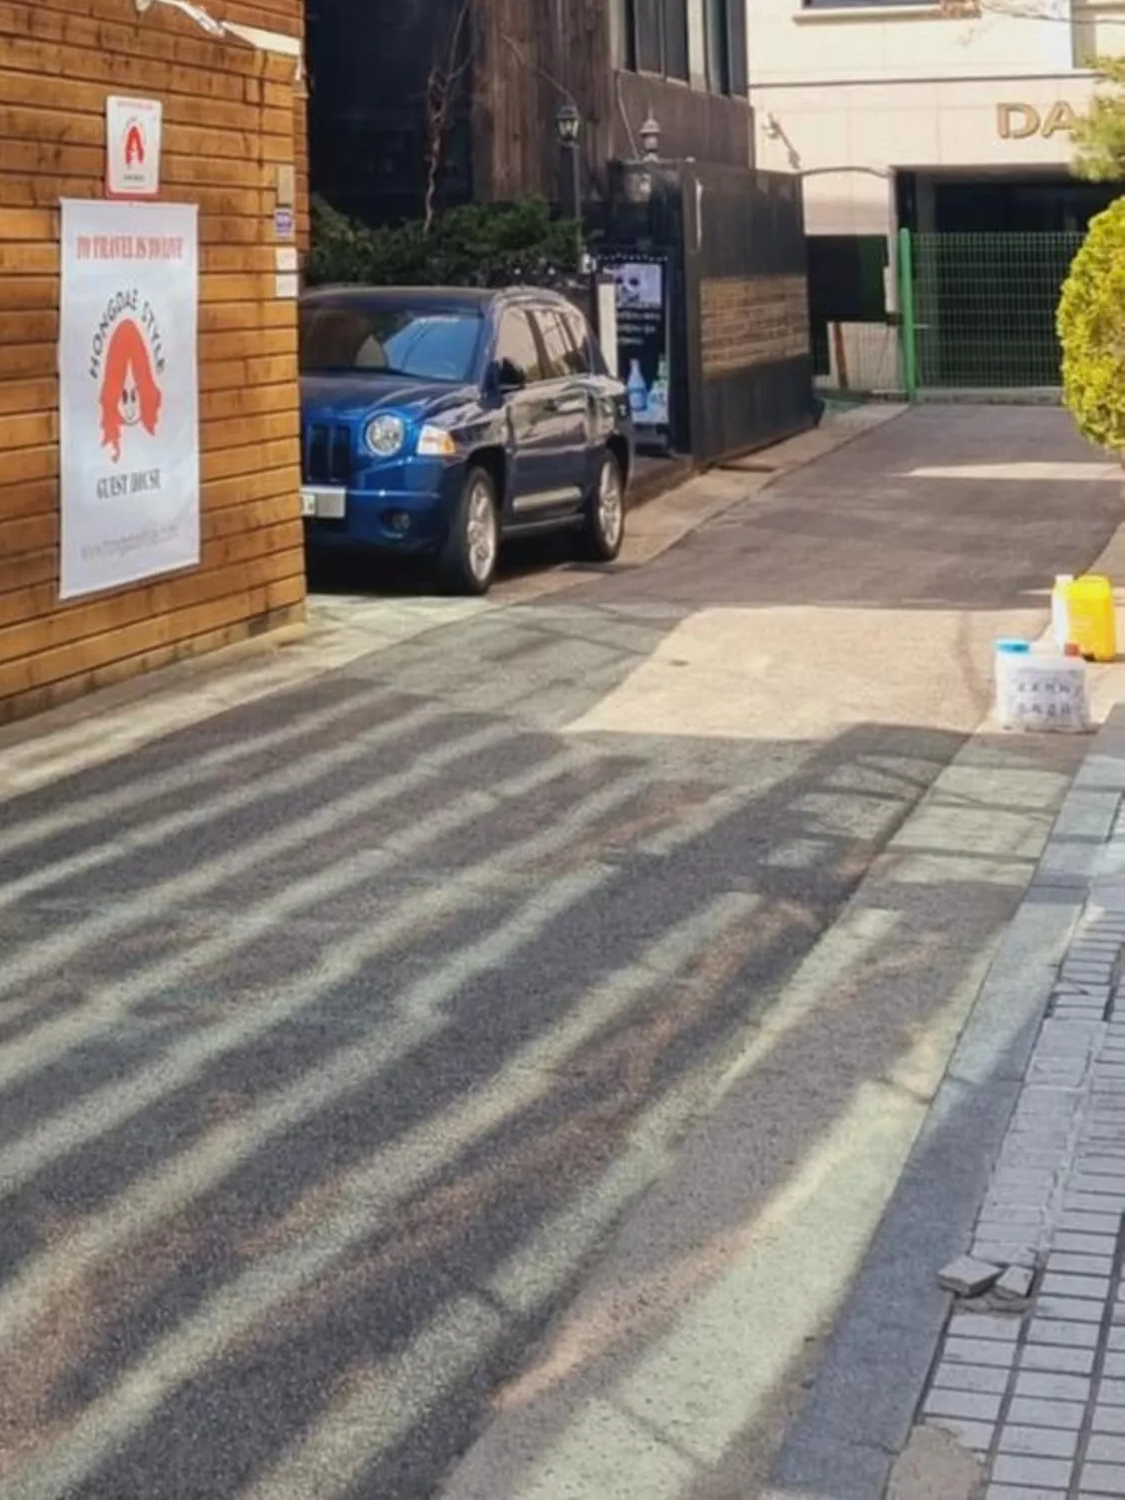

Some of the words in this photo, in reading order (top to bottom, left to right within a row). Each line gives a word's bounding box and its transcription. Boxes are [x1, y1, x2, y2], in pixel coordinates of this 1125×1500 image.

[89, 287, 139, 380] HONGDAE
[140, 301, 166, 376] STYLE
[96, 473, 128, 500] GUEST
